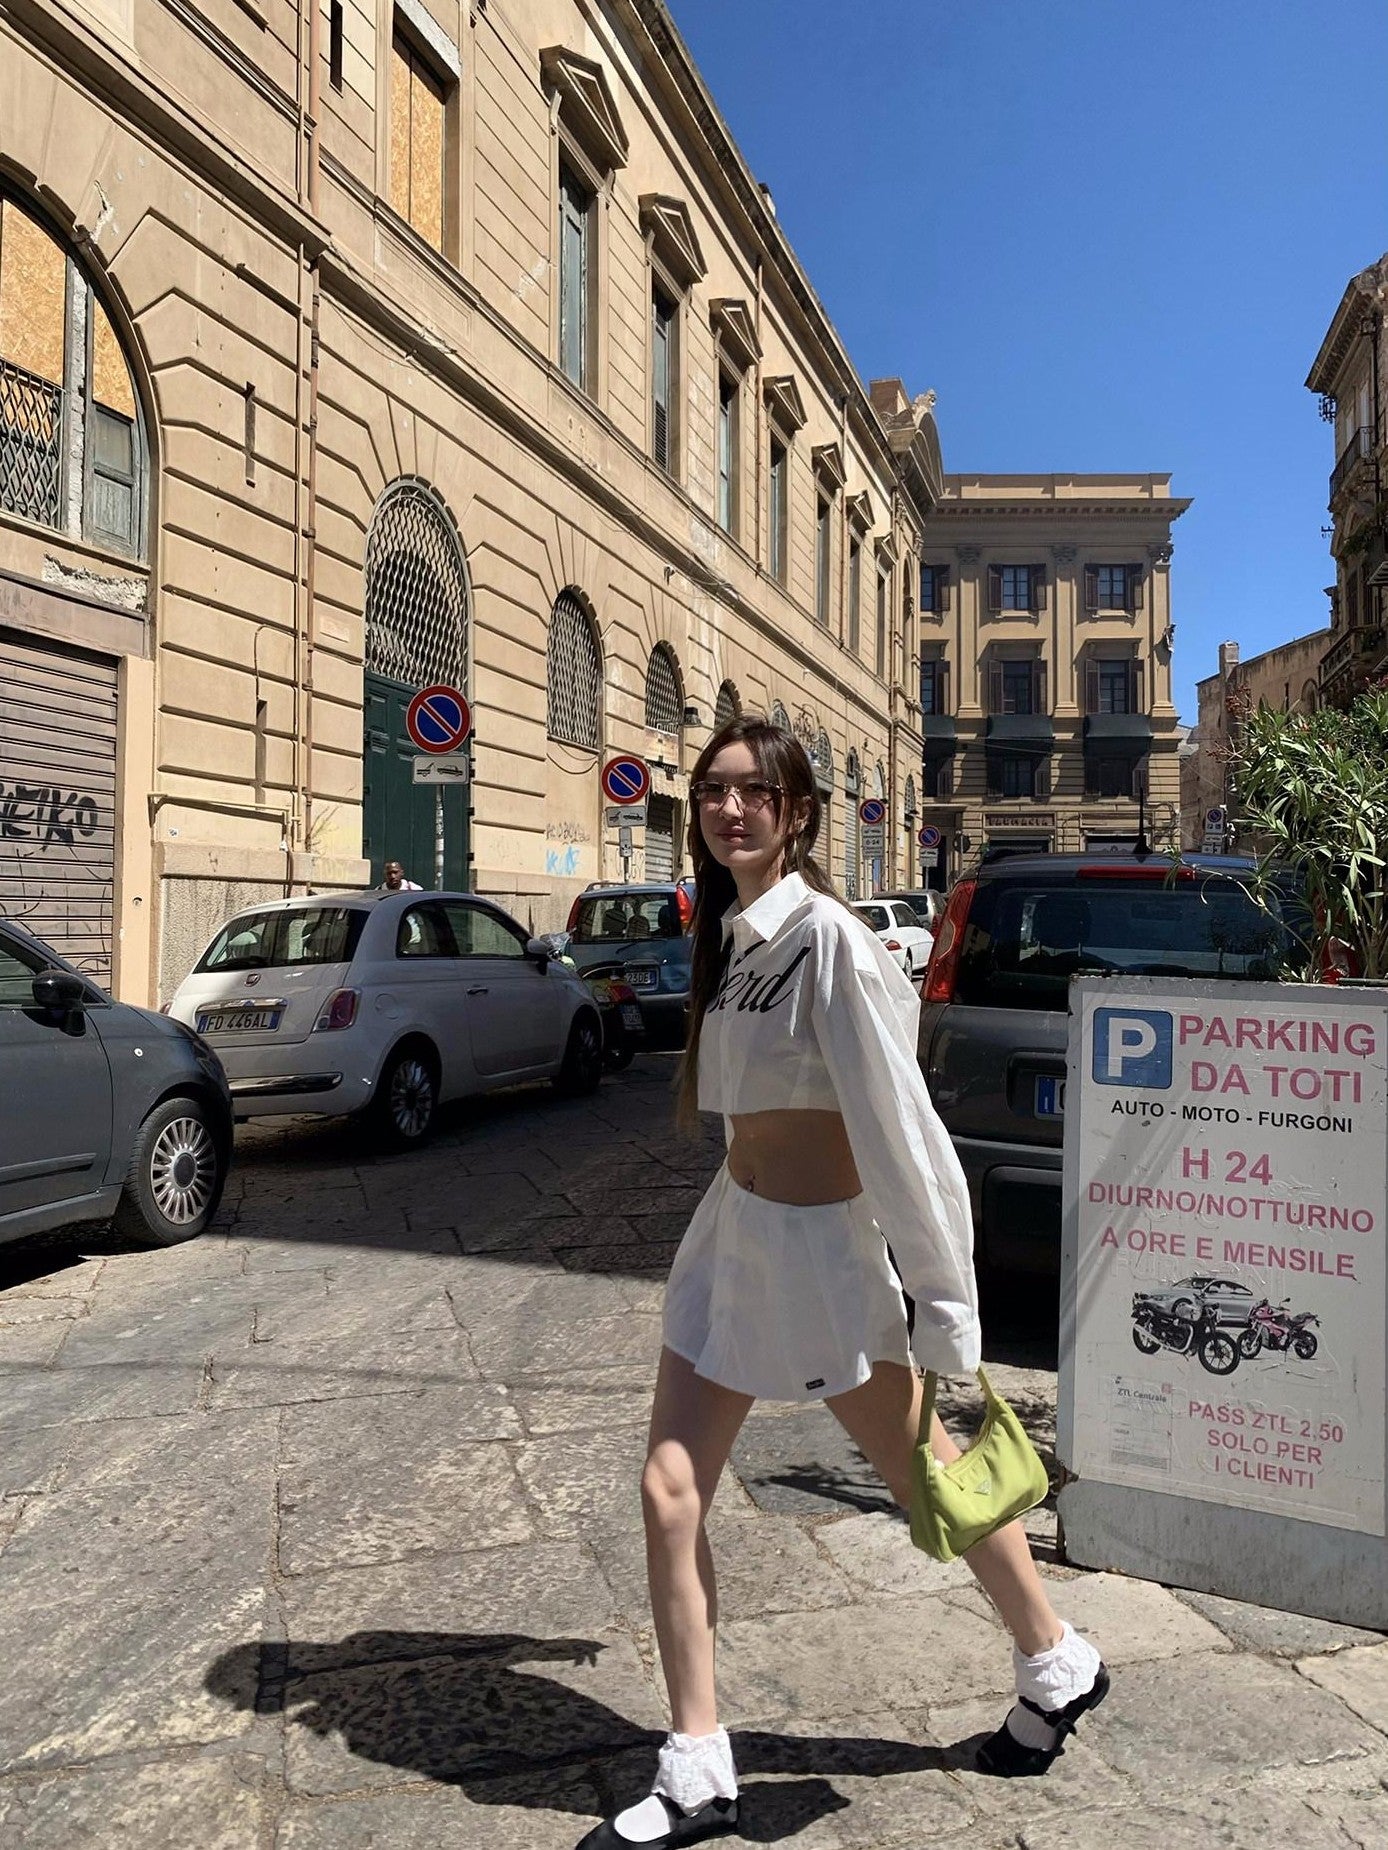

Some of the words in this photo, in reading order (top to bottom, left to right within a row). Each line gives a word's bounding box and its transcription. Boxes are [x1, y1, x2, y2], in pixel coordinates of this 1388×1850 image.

[206, 1014, 224, 1031] FD
[226, 1012, 268, 1029] 446AL
[1179, 1014, 1376, 1057] PARKING
[1107, 1016, 1157, 1078] P
[1190, 1061, 1251, 1095] DA
[1262, 1065, 1362, 1104] TOTI
[1111, 1099, 1164, 1118] AUTO
[1182, 1105, 1240, 1124] MOTO
[1258, 1111, 1353, 1134] FURGONI
[1181, 1147, 1210, 1180] H
[1224, 1150, 1274, 1186] 24
[1089, 1182, 1375, 1234] DIURNO/NOTTURNO
[1100, 1226, 1119, 1249] A
[1127, 1229, 1186, 1257] ORE
[1196, 1237, 1213, 1260] E
[1223, 1240, 1356, 1278] MENSILE
[1188, 1401, 1245, 1426] PASS
[1251, 1408, 1293, 1435] ZTL
[1207, 1429, 1270, 1458] SOLO
[1276, 1443, 1322, 1465] PER
[1214, 1456, 1221, 1473] I
[1227, 1458, 1315, 1490] CLIENTI
